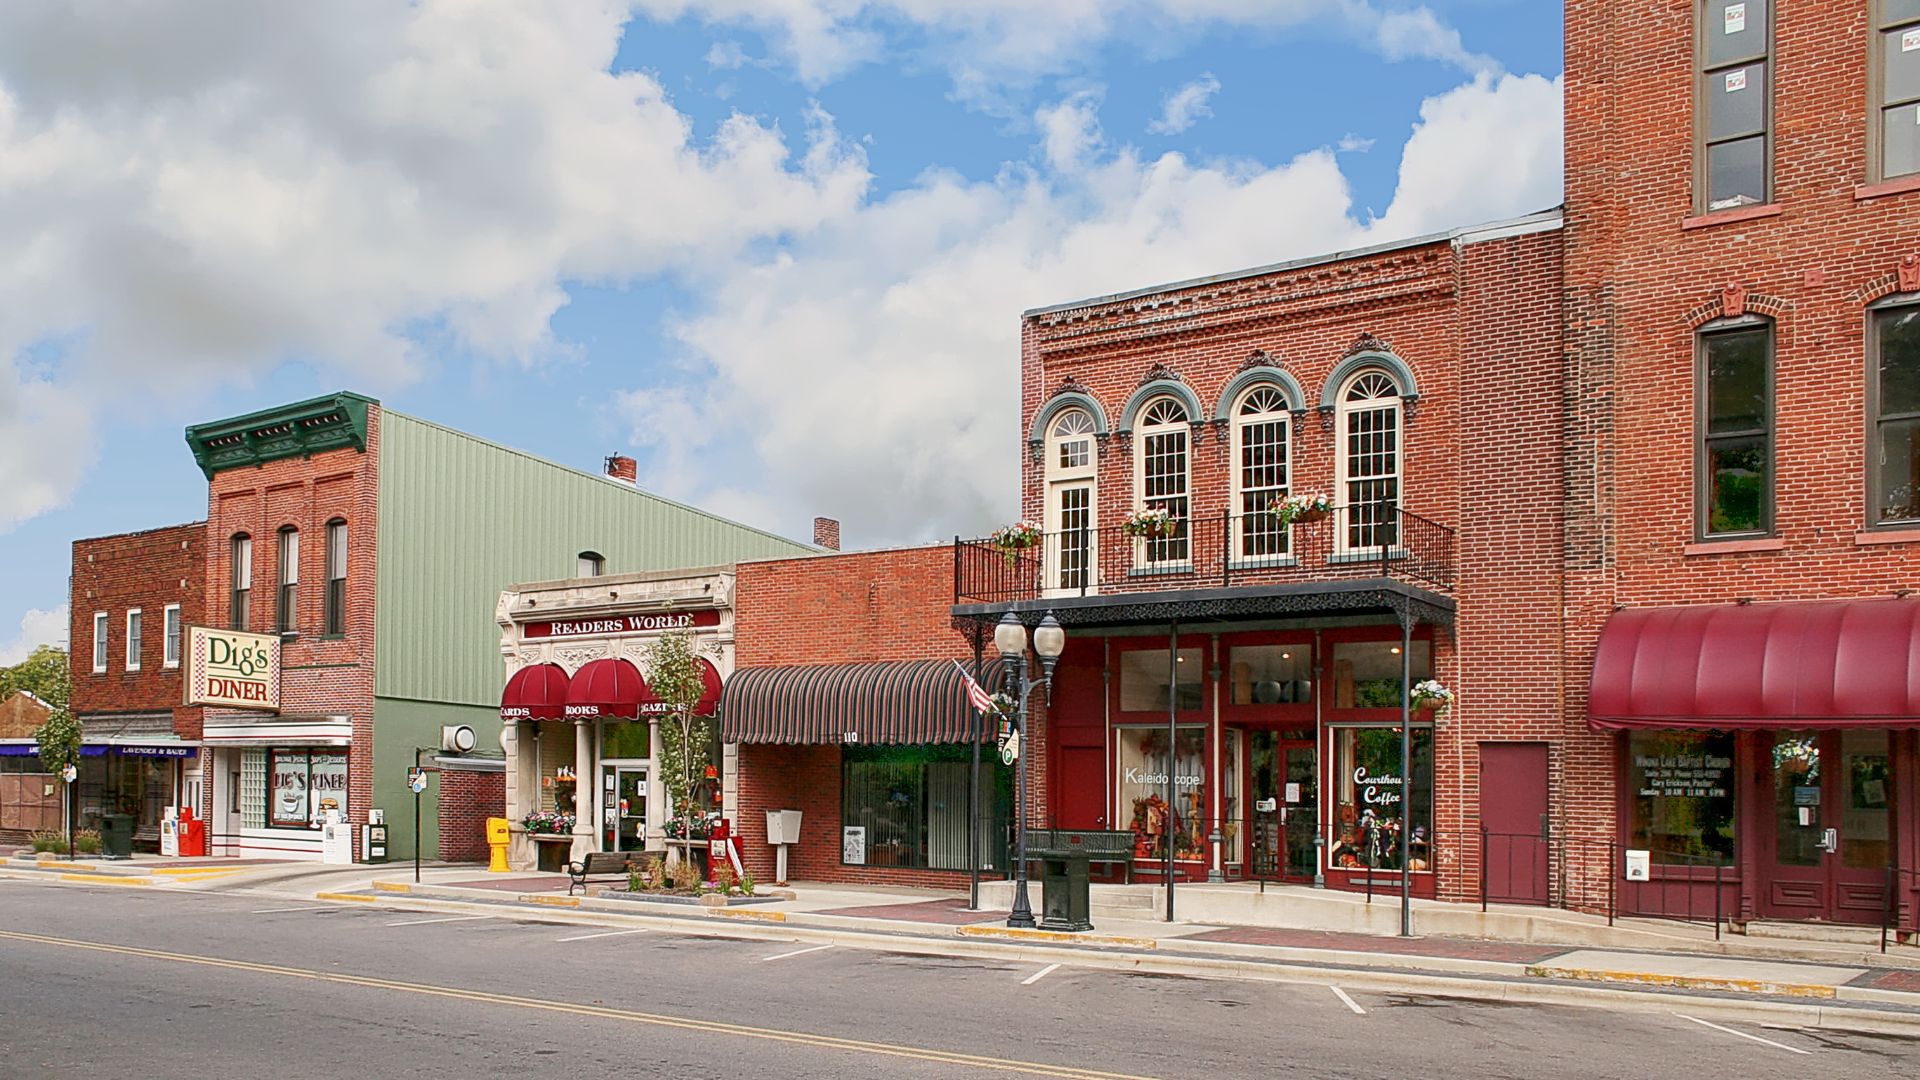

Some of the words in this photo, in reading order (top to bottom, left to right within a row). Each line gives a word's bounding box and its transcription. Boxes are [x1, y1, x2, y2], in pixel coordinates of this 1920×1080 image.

[550, 619, 623, 635] READERS
[628, 615, 690, 630] WORLD
[208, 637, 268, 676] Dig's
[207, 678, 268, 701] DINER
[844, 731, 858, 742] 110
[1005, 750, 1012, 761] P
[1125, 767, 1200, 787] Kaleidocope
[1364, 786, 1401, 805] Coffee
[1640, 788, 1660, 797] Sunday
